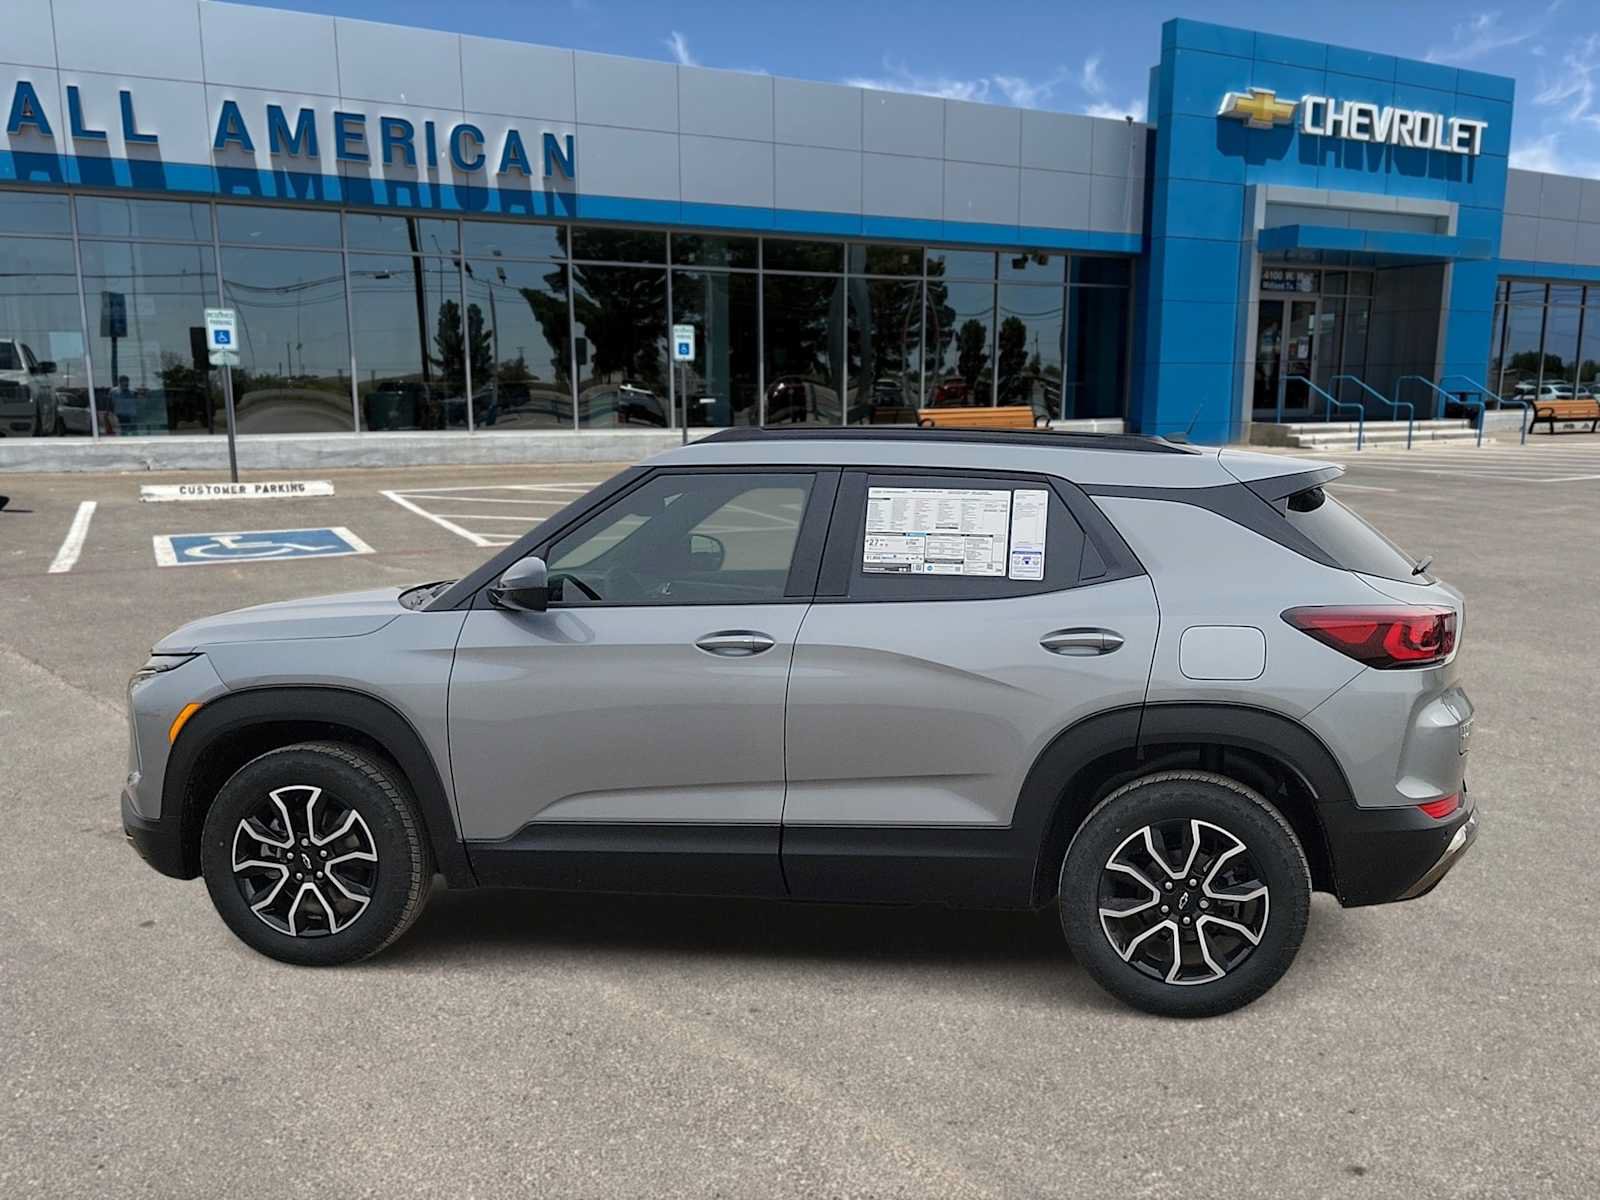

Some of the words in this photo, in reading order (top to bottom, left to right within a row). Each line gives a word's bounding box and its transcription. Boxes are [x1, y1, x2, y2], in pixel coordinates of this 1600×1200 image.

[7, 80, 158, 143] ALL
[212, 99, 575, 179] AMERICAN
[1301, 94, 1488, 155] CHEVROLET
[179, 484, 247, 495] CUSTOMER
[254, 482, 306, 493] PARKING
